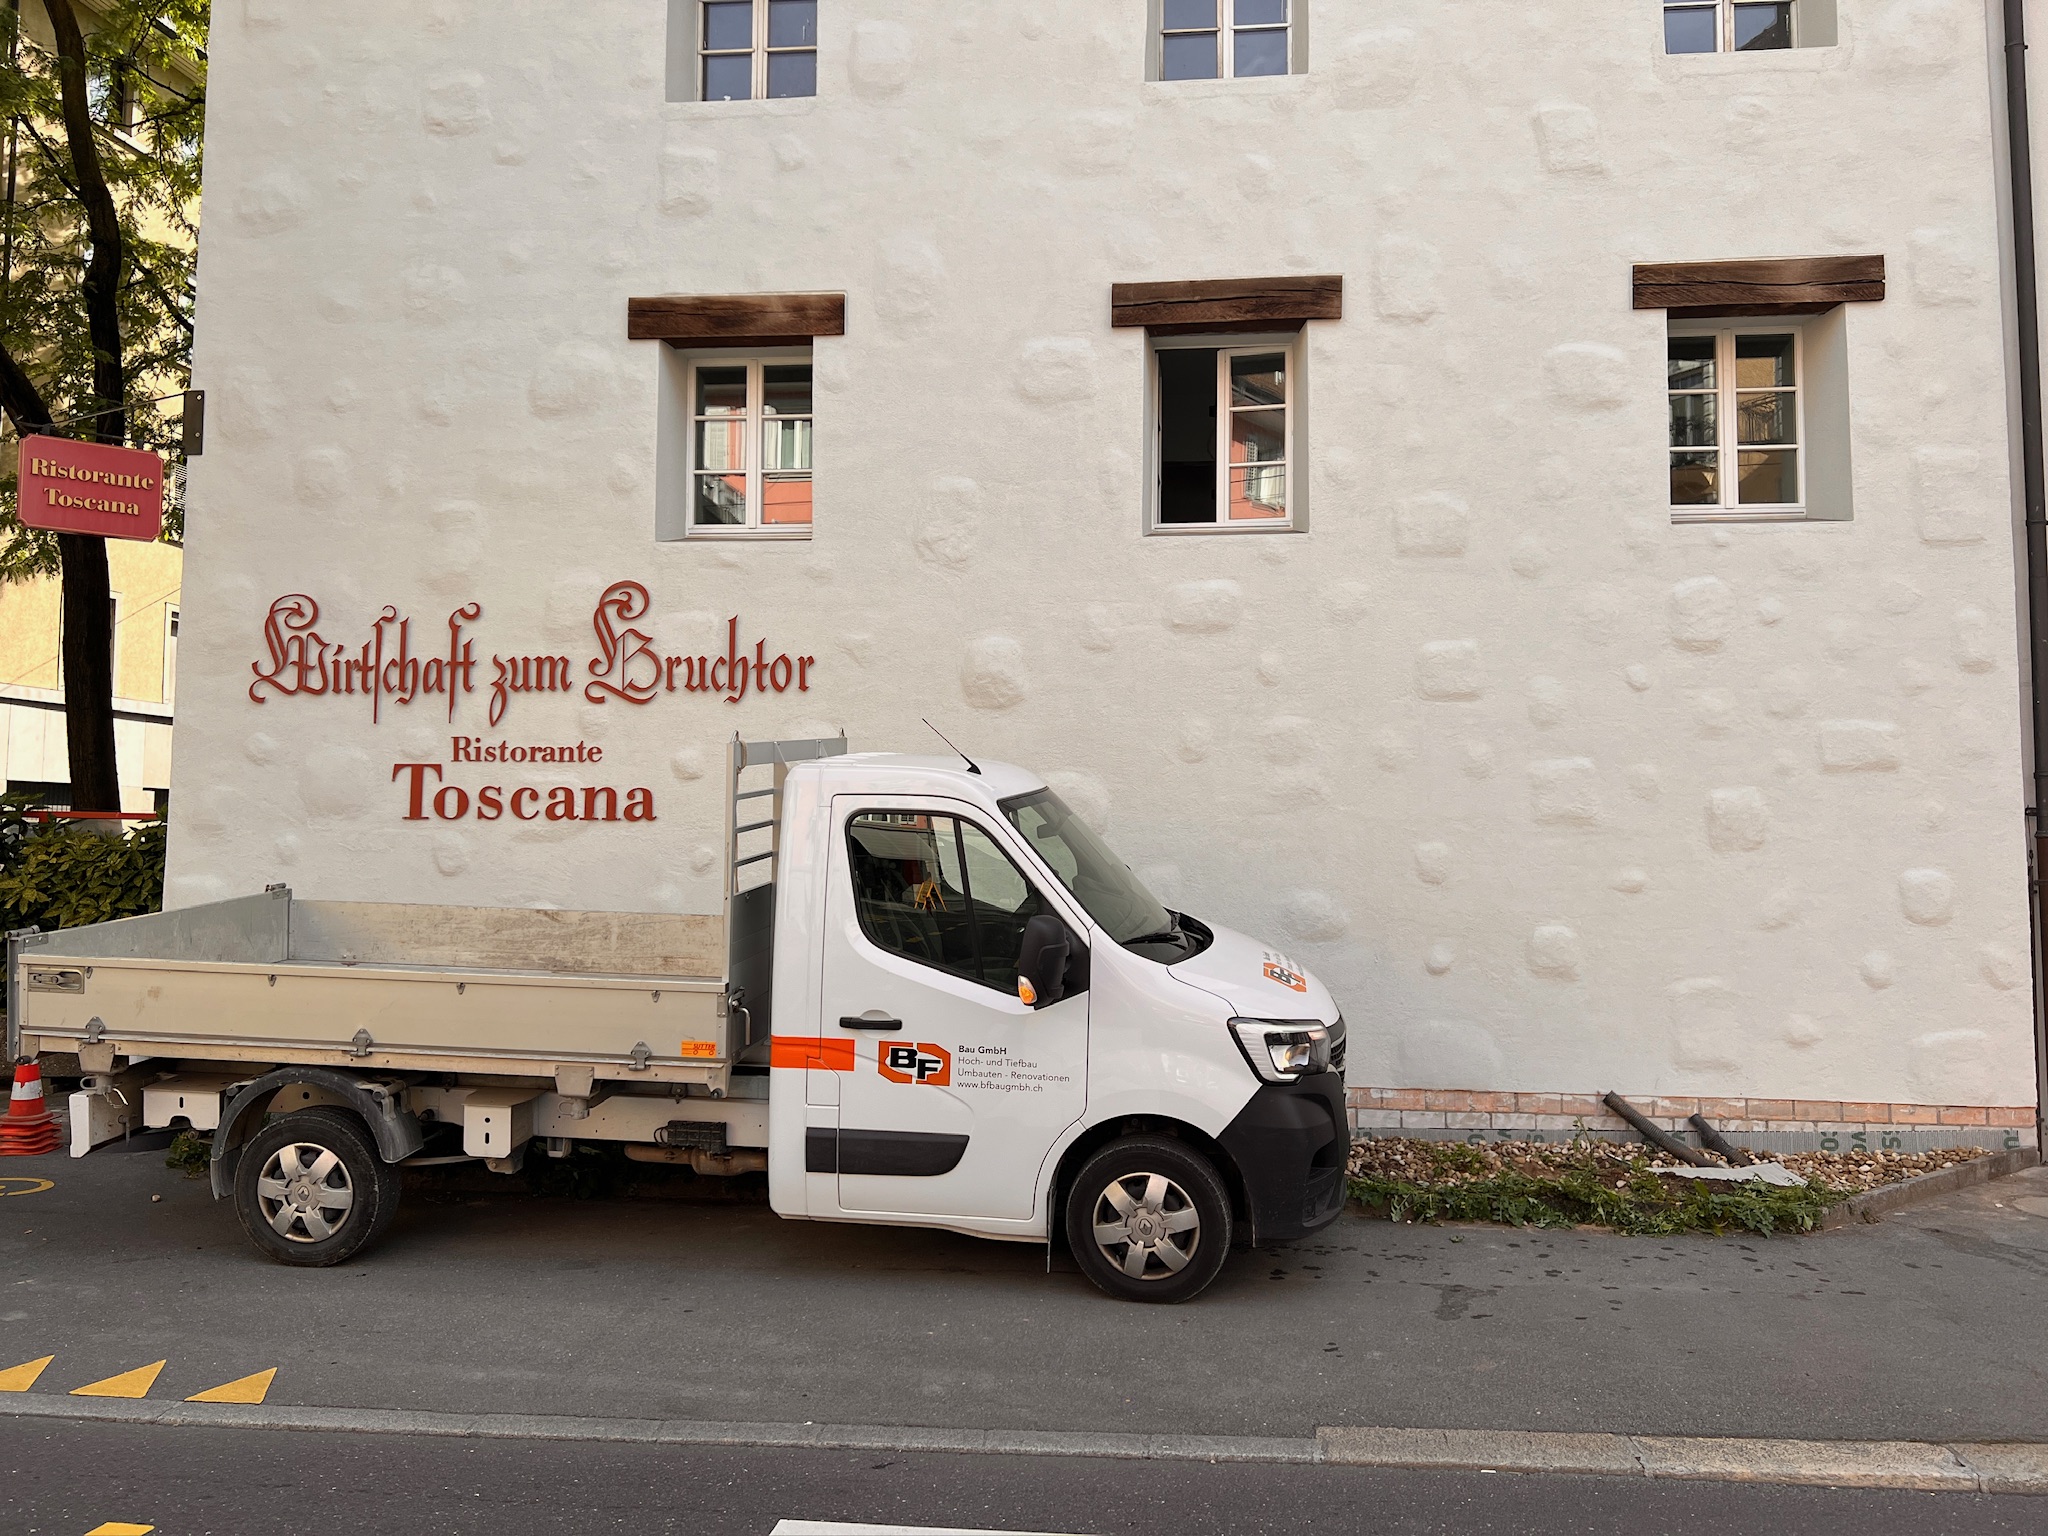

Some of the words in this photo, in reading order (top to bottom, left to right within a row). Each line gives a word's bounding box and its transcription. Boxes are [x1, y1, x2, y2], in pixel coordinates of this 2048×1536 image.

[30, 457, 155, 491] Ristorante
[43, 487, 140, 516] Toscana
[489, 655, 572, 727] zum
[584, 580, 815, 705] Bruchtor
[451, 735, 603, 764] Ristorante
[391, 763, 657, 822] Toscana
[889, 1047, 942, 1081] BF
[958, 1044, 975, 1054] Bau
[977, 1045, 1007, 1055] GmbH
[958, 1056, 984, 1066] Hoch-
[986, 1058, 1003, 1067] und
[1005, 1058, 1038, 1069] Tiefbau
[957, 1067, 1003, 1079] Umbauten
[1010, 1070, 1070, 1083] Renovationen
[957, 1080, 1043, 1093] www.bfbaugmbh.ch
